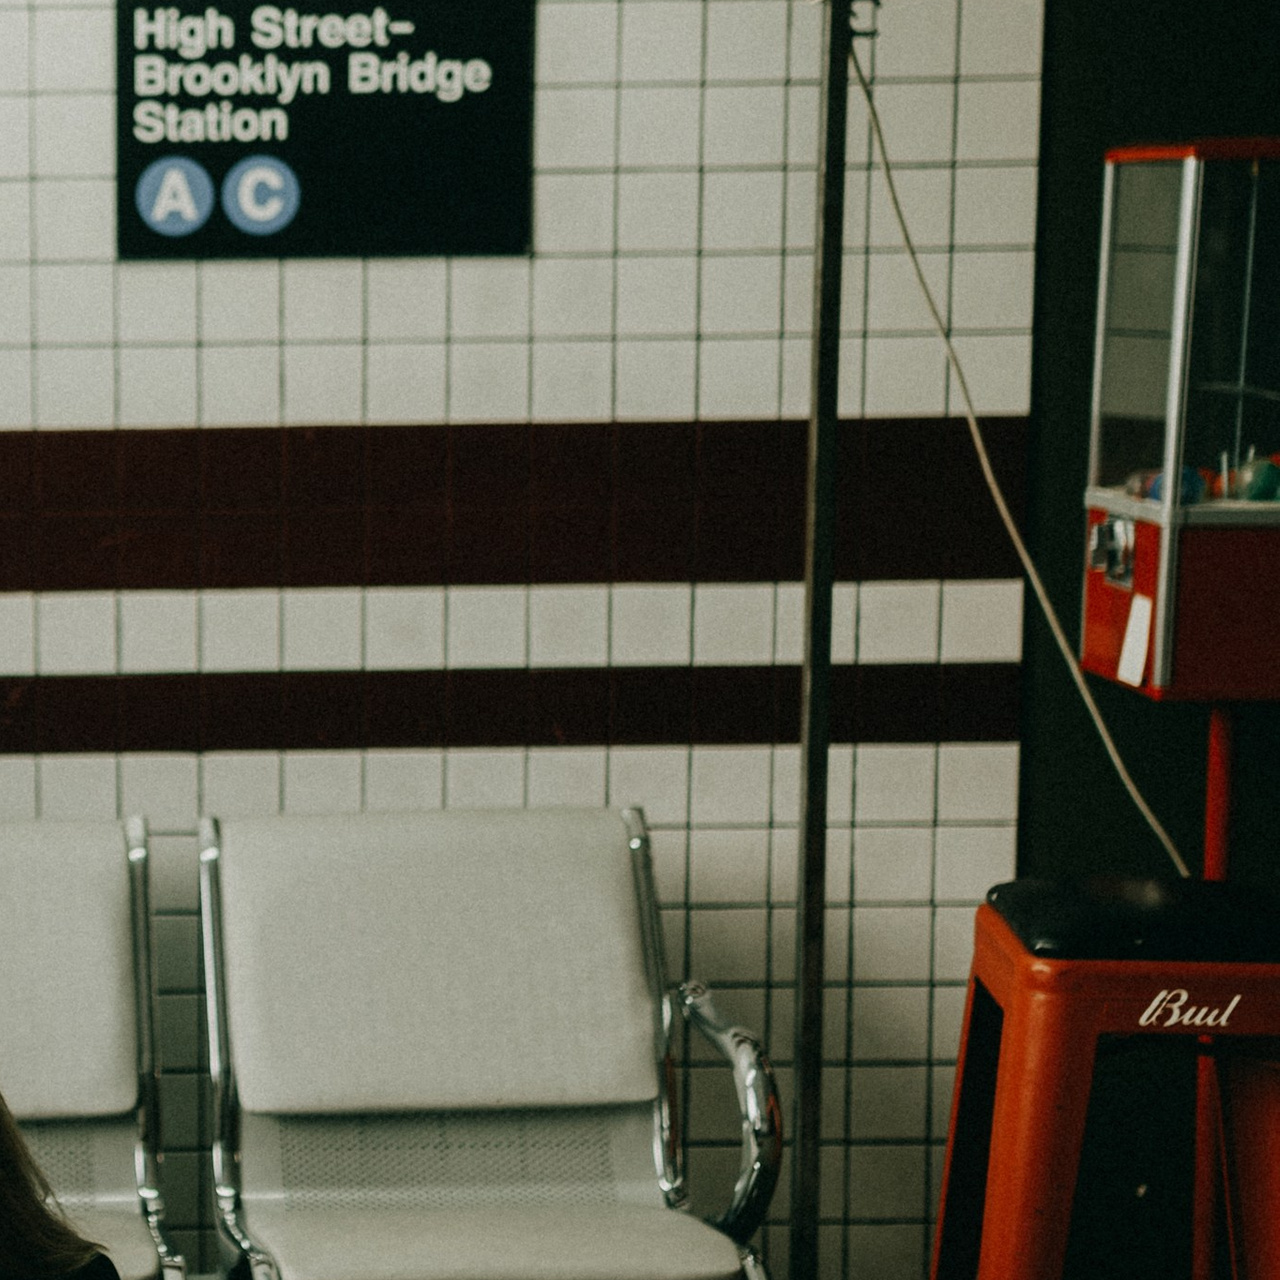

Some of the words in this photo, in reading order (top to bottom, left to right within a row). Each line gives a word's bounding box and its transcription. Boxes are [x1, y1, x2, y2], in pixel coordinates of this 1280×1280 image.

[133, 6, 235, 59] High
[133, 53, 331, 103] Brooklyn
[347, 51, 493, 103] Bridge
[132, 99, 289, 143] Station
[151, 167, 200, 222] A
[236, 166, 285, 222] C
[1138, 988, 1242, 1027] Bud
